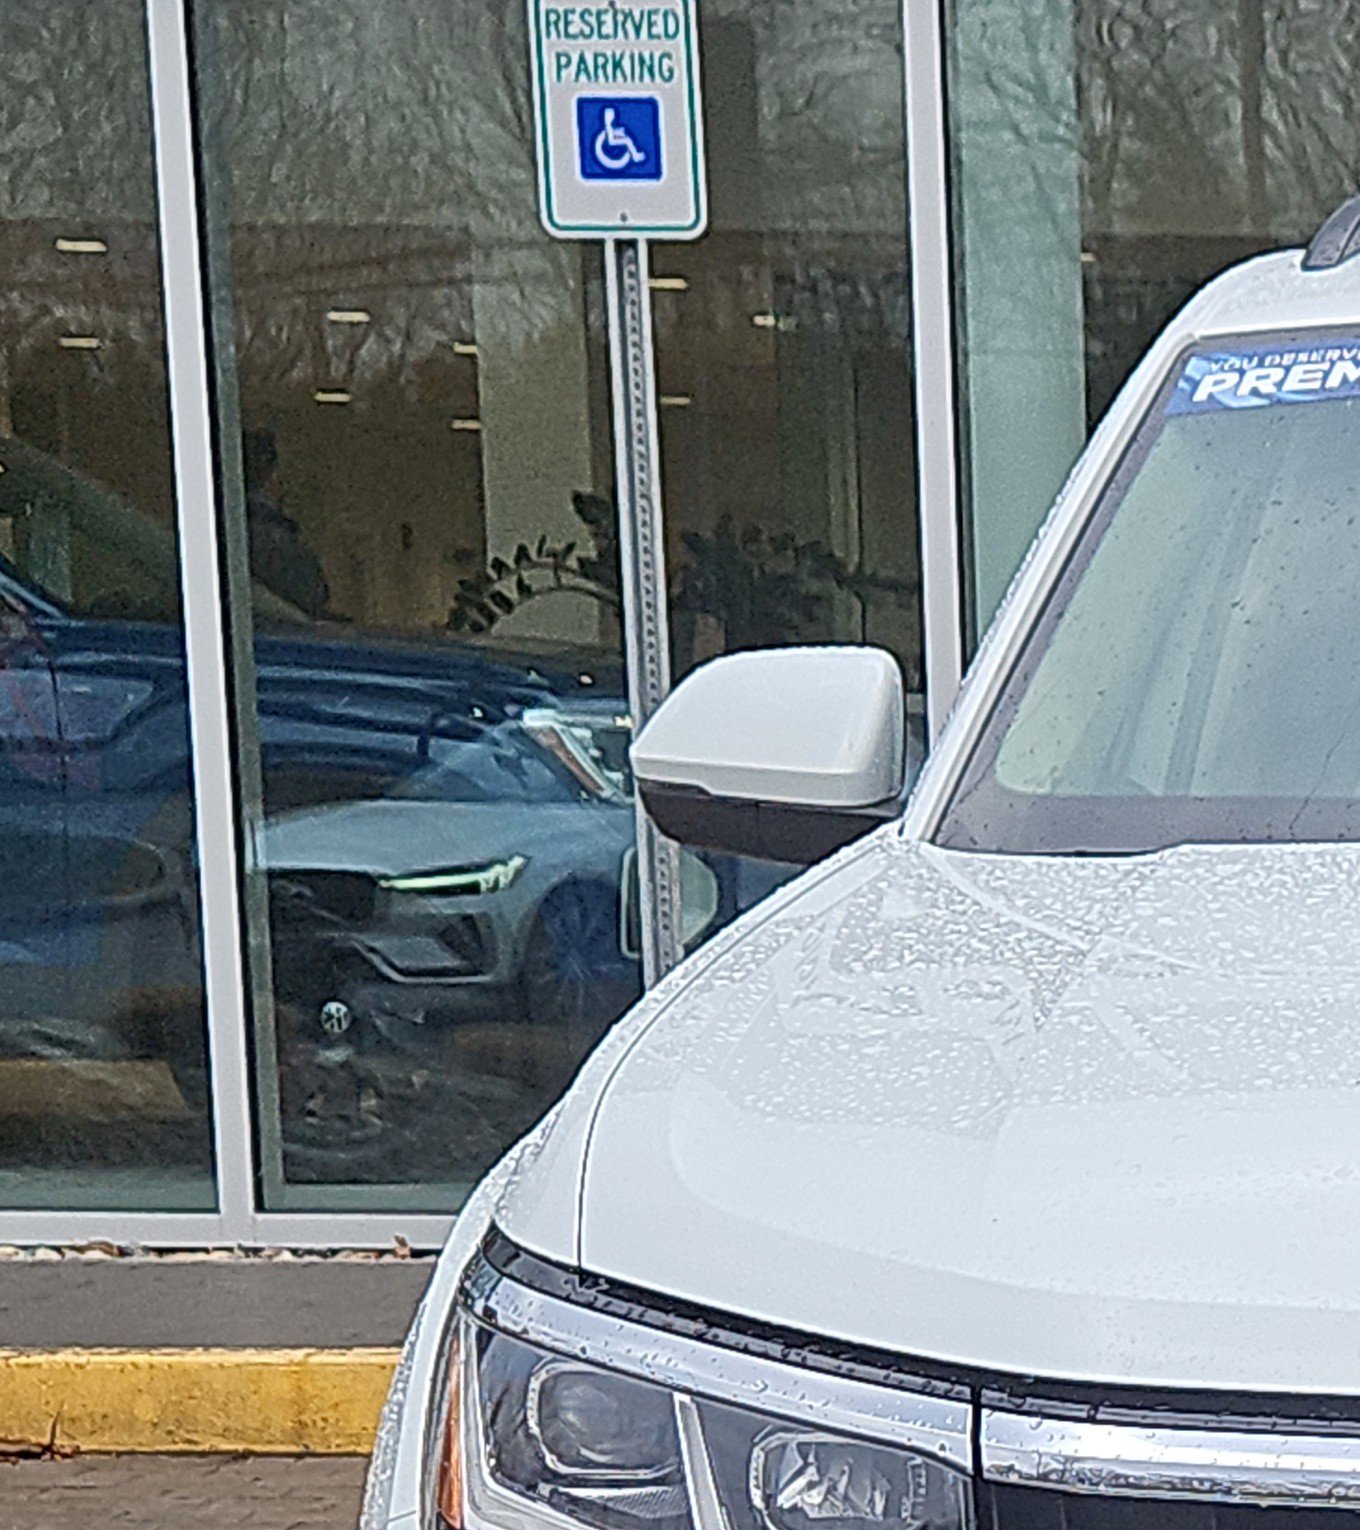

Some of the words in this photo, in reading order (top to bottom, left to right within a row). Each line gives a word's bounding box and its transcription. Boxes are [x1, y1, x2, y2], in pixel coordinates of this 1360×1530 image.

[545, 7, 681, 41] RESERVED
[555, 51, 676, 84] PARKING
[1211, 355, 1257, 371] YOU
